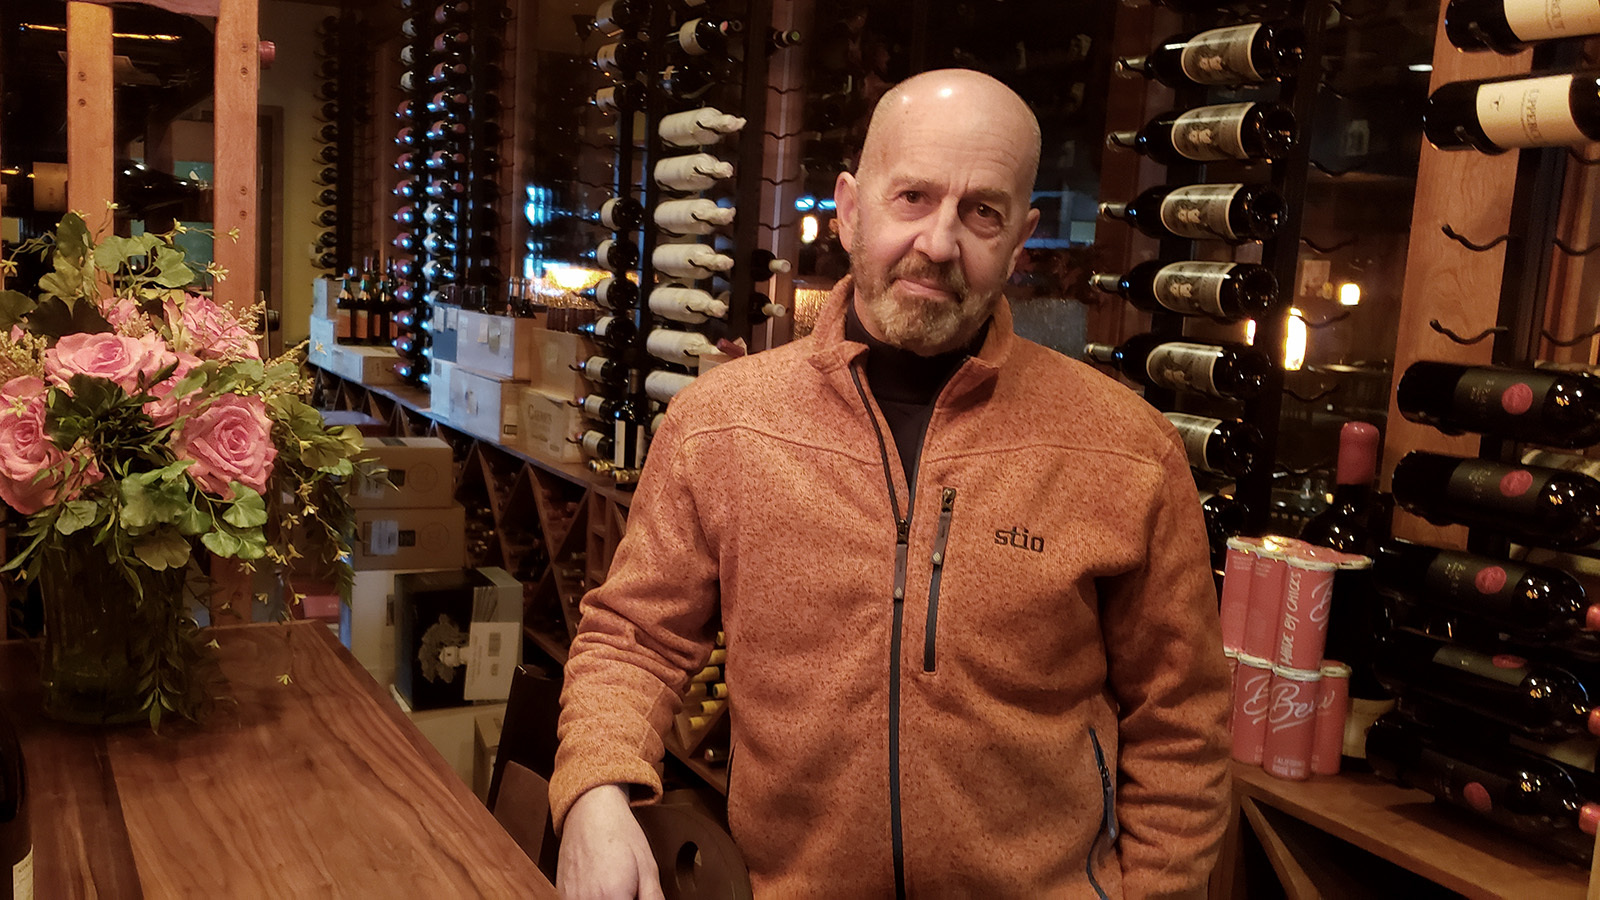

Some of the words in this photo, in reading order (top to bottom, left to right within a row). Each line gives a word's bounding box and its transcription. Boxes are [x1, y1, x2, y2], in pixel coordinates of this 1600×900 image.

[994, 526, 1045, 553] stio
[1286, 571, 1302, 613] CHICKS
[1284, 612, 1300, 631] BY
[1280, 632, 1295, 667] MADE
